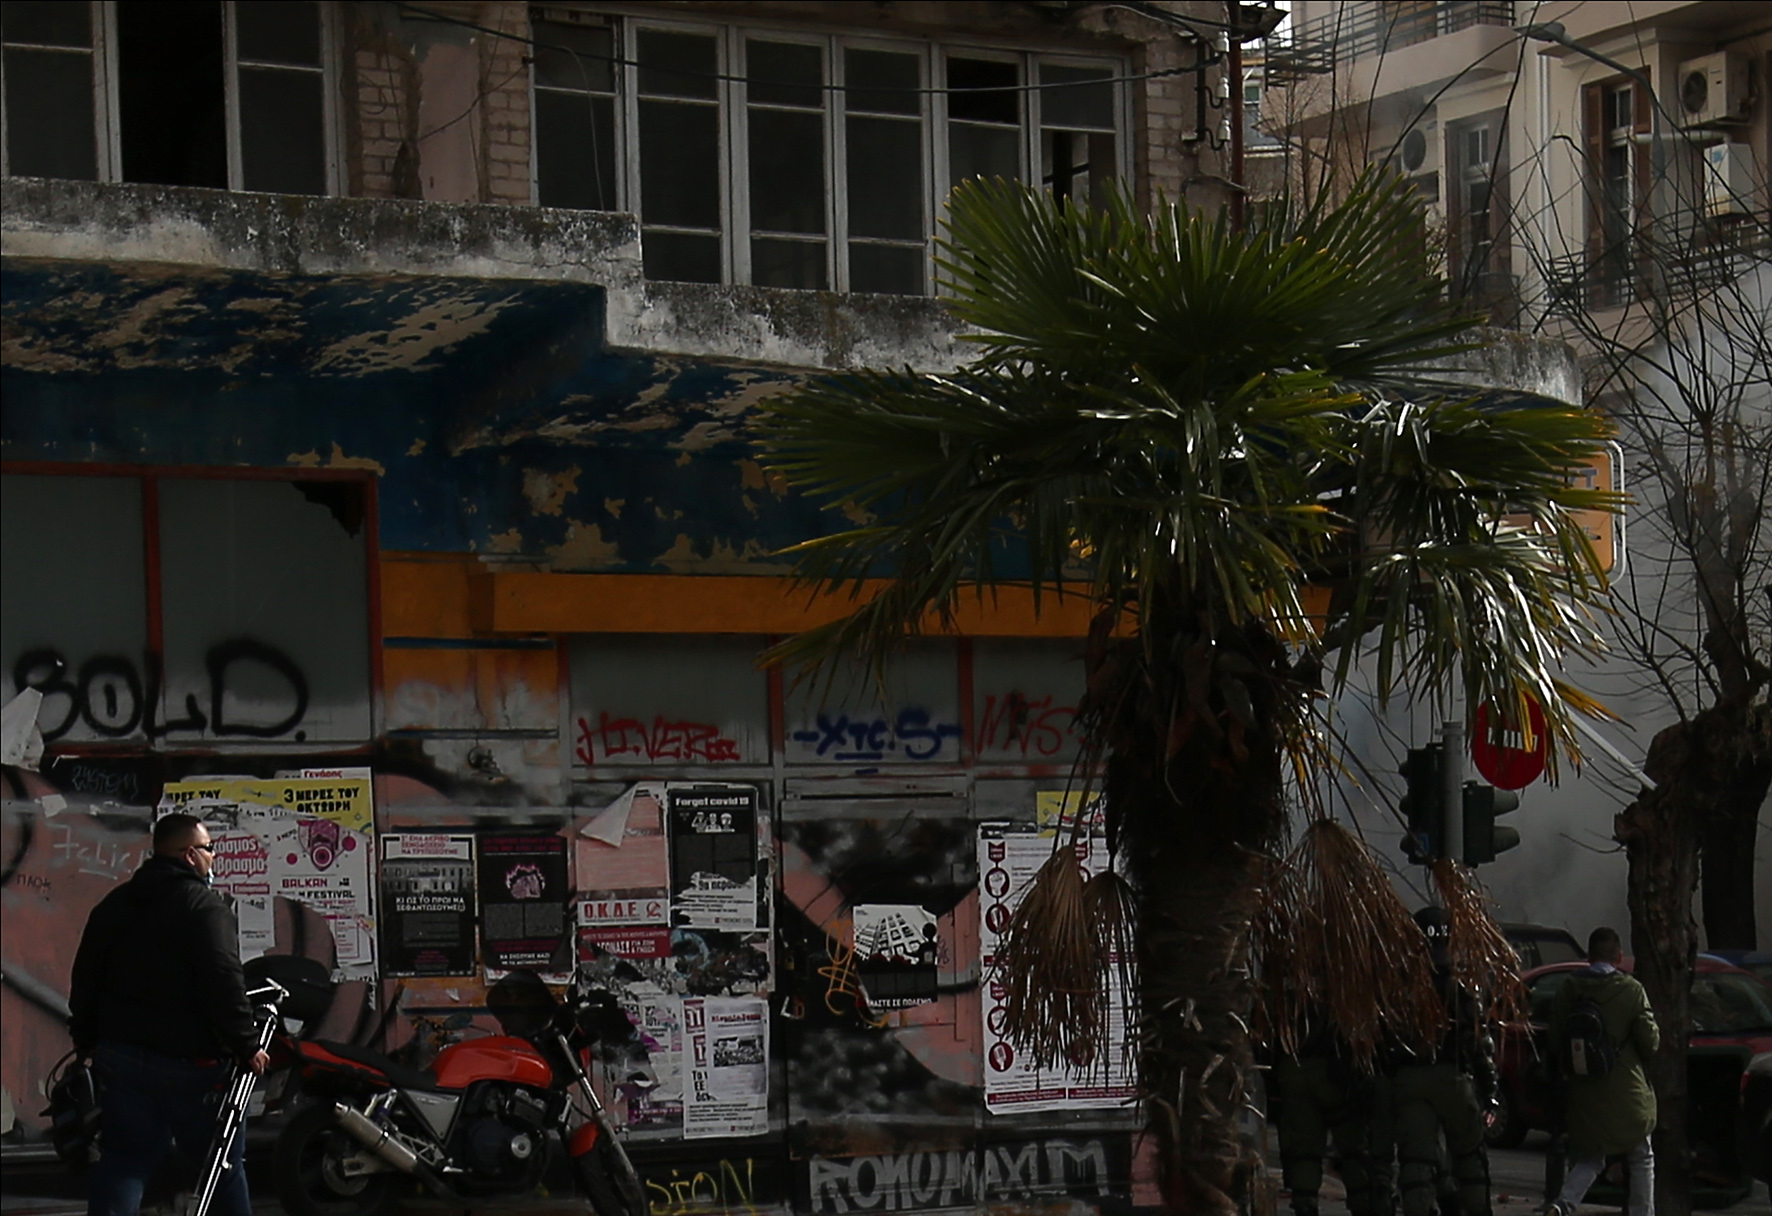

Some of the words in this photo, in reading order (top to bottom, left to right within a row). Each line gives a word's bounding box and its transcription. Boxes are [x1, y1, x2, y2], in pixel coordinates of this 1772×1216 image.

[284, 789, 294, 803] 3
[296, 789, 334, 801] ΜΕΡΕΣ
[338, 787, 359, 799] ΤΟΥ
[282, 878, 328, 888] BALKAN
[307, 890, 355, 898] FESTIVAL
